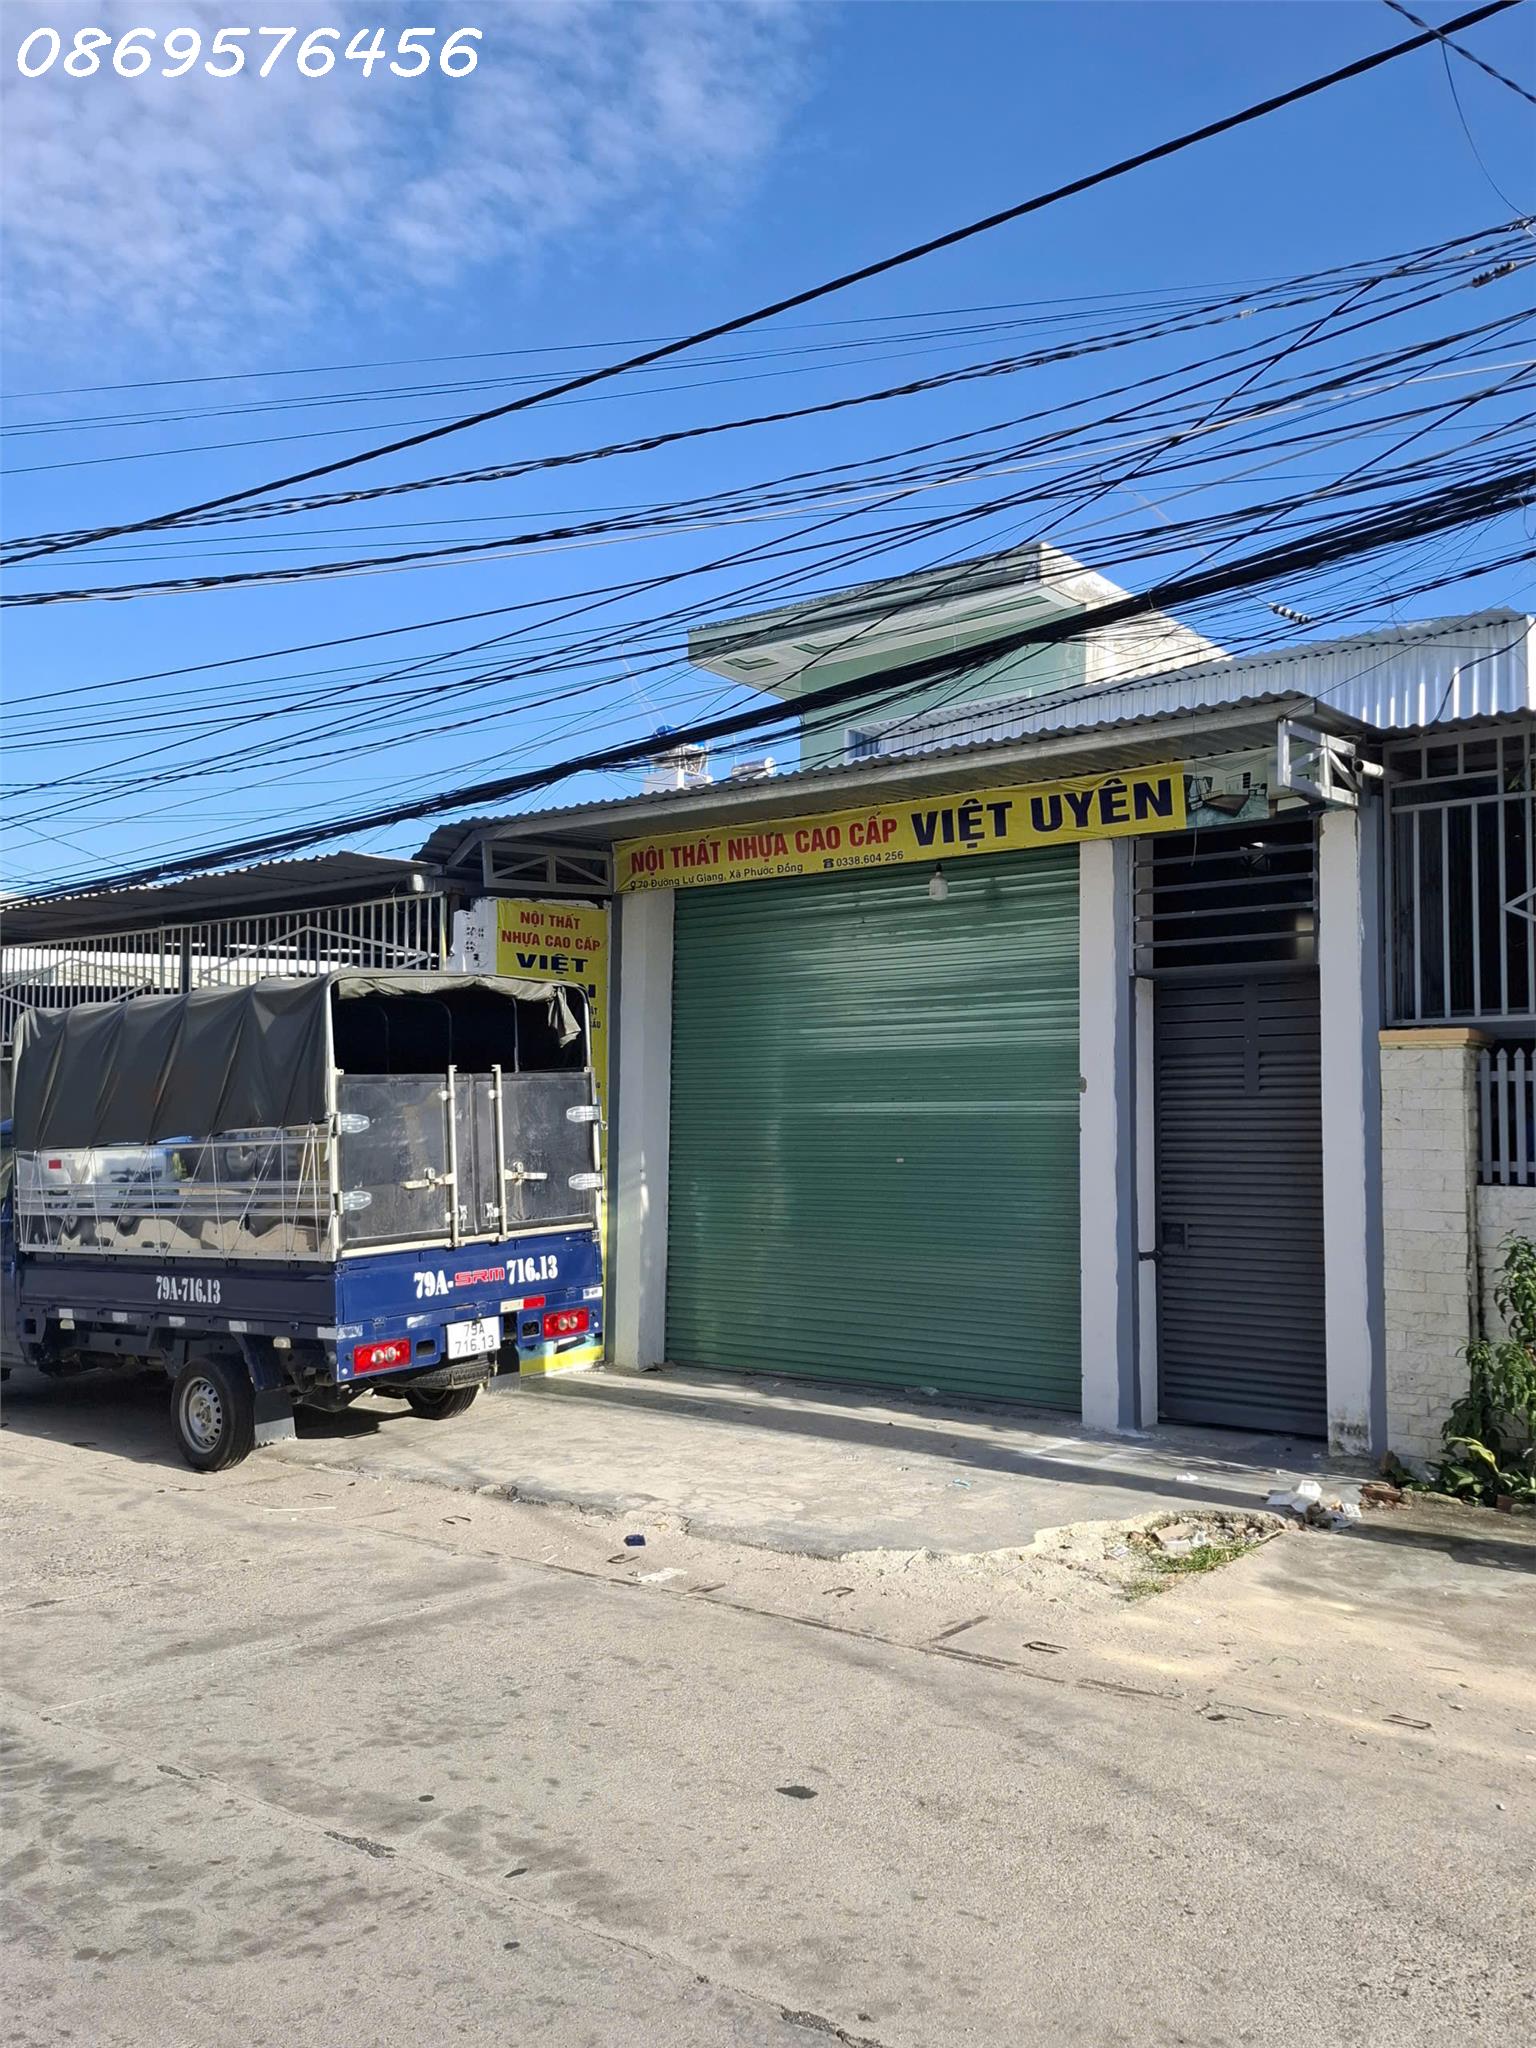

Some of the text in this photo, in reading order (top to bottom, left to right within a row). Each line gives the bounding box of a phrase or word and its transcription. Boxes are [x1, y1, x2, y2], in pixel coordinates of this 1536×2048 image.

[630, 777, 1173, 876] NỘI THẤT NHỰA CAO CẤP VIỆT UYÊN
[651, 878, 680, 889] Đường
[743, 866, 774, 878] Phước
[777, 862, 803, 875] Đồng
[884, 850, 904, 862] 256
[520, 910, 580, 930] NỘI THẤT
[501, 929, 541, 948] NHỰA
[544, 934, 571, 949] CAO
[575, 935, 601, 951] CẤP
[516, 952, 589, 975] VIỆT
[454, 1267, 505, 1287] SRM
[506, 1255, 559, 1286] 716.13
[156, 1275, 221, 1304] 79A-716.13
[455, 1334, 495, 1355] 716.13
